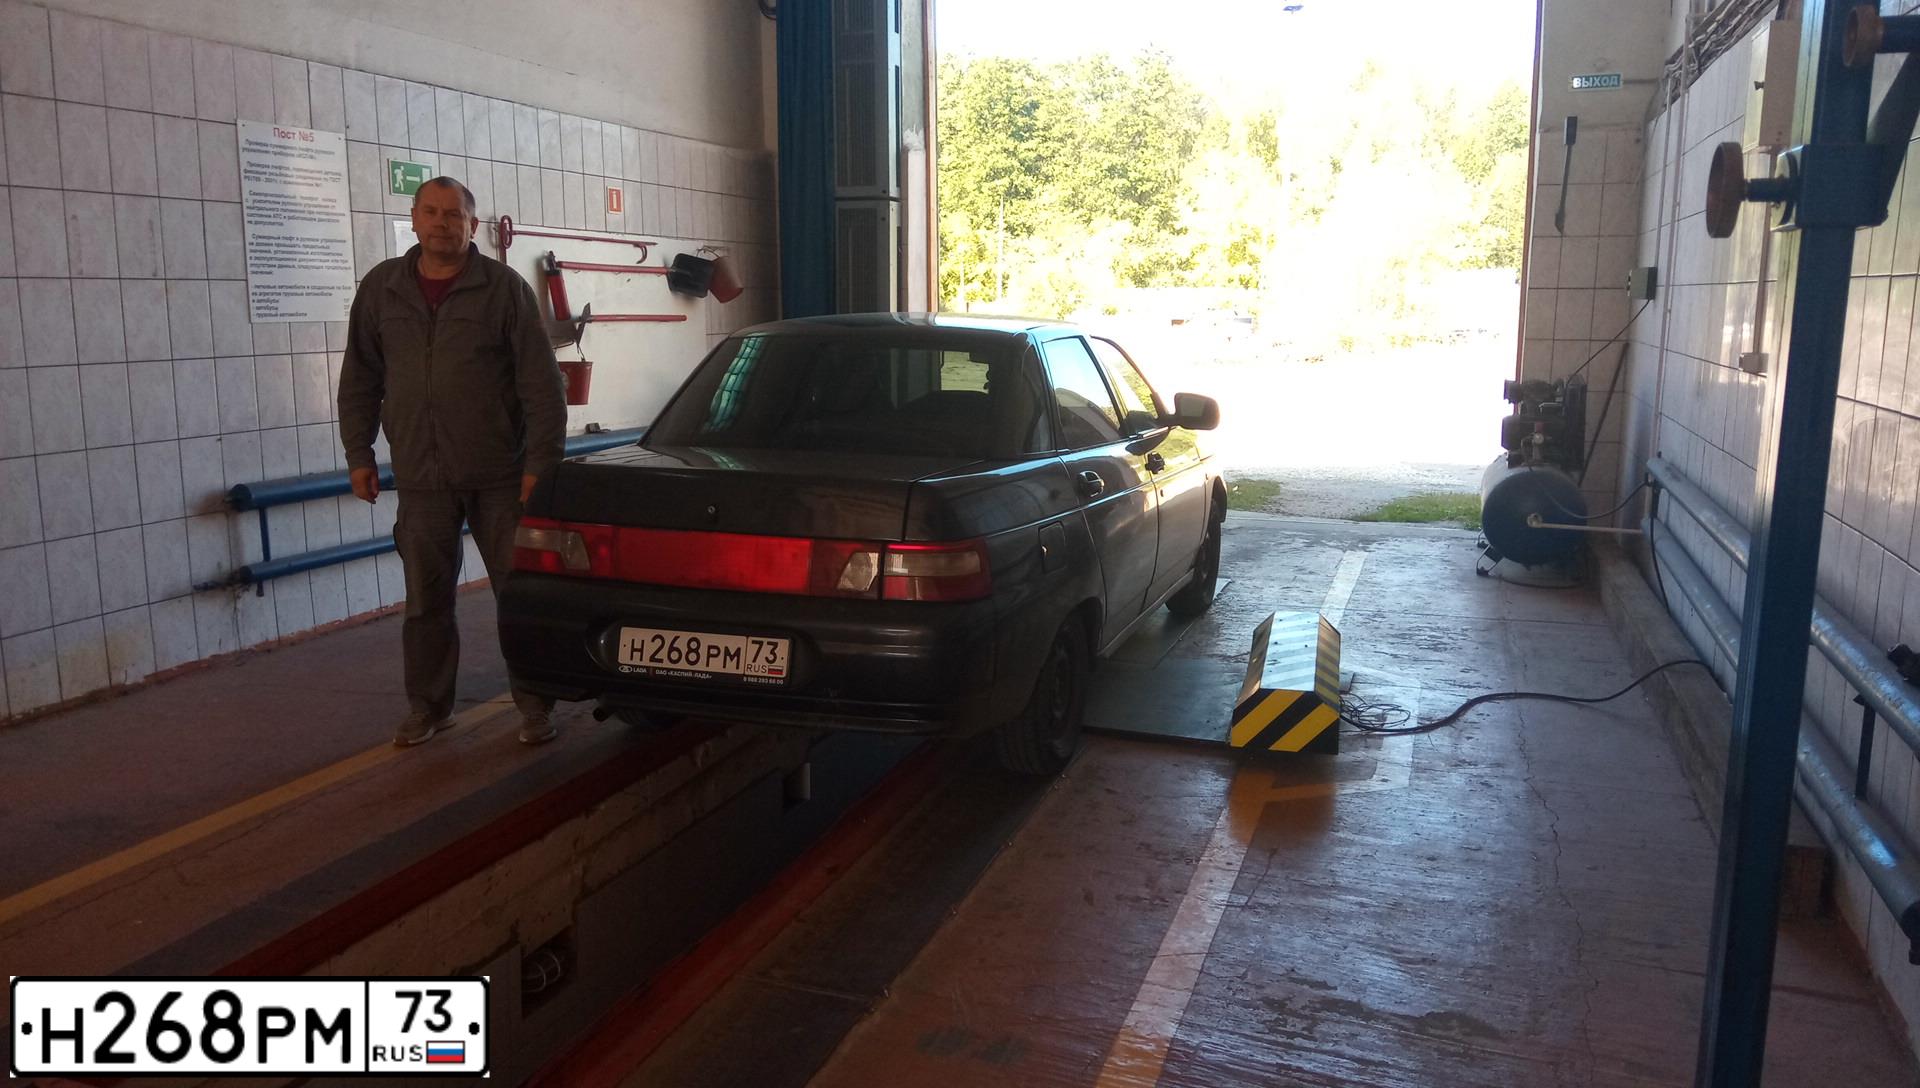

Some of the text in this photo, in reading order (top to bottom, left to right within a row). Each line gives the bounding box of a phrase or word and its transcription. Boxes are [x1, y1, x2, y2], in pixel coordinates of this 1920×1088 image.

[1573, 75, 1619, 88] ВЫХОД
[273, 127, 315, 142] Пост №5
[630, 634, 779, 670] Н268РМ 73
[746, 664, 767, 674] RUS
